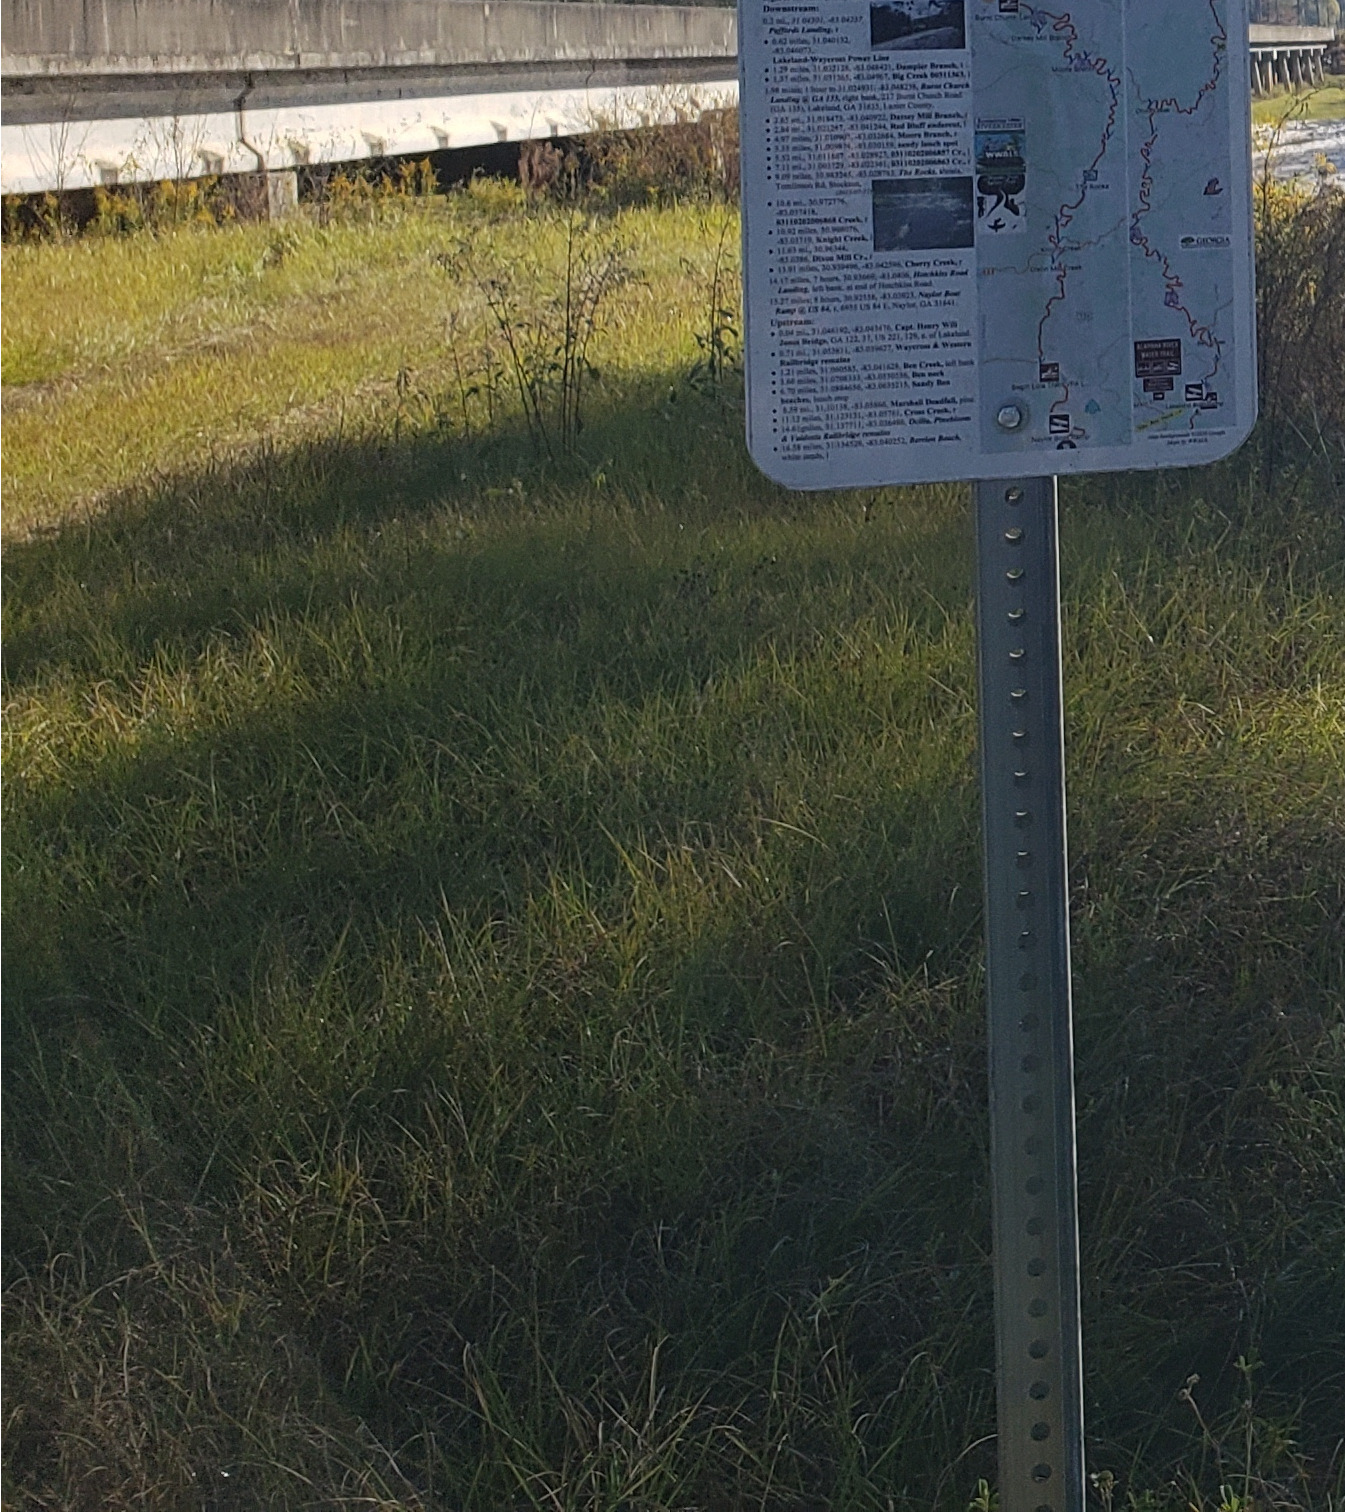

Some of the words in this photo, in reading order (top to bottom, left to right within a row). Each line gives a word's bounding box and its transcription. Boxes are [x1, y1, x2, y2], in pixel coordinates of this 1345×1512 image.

[763, 4, 819, 13] Downstream:
[873, 54, 890, 62] Line
[904, 259, 930, 269] Cherry
[770, 318, 815, 328] Upstream:
